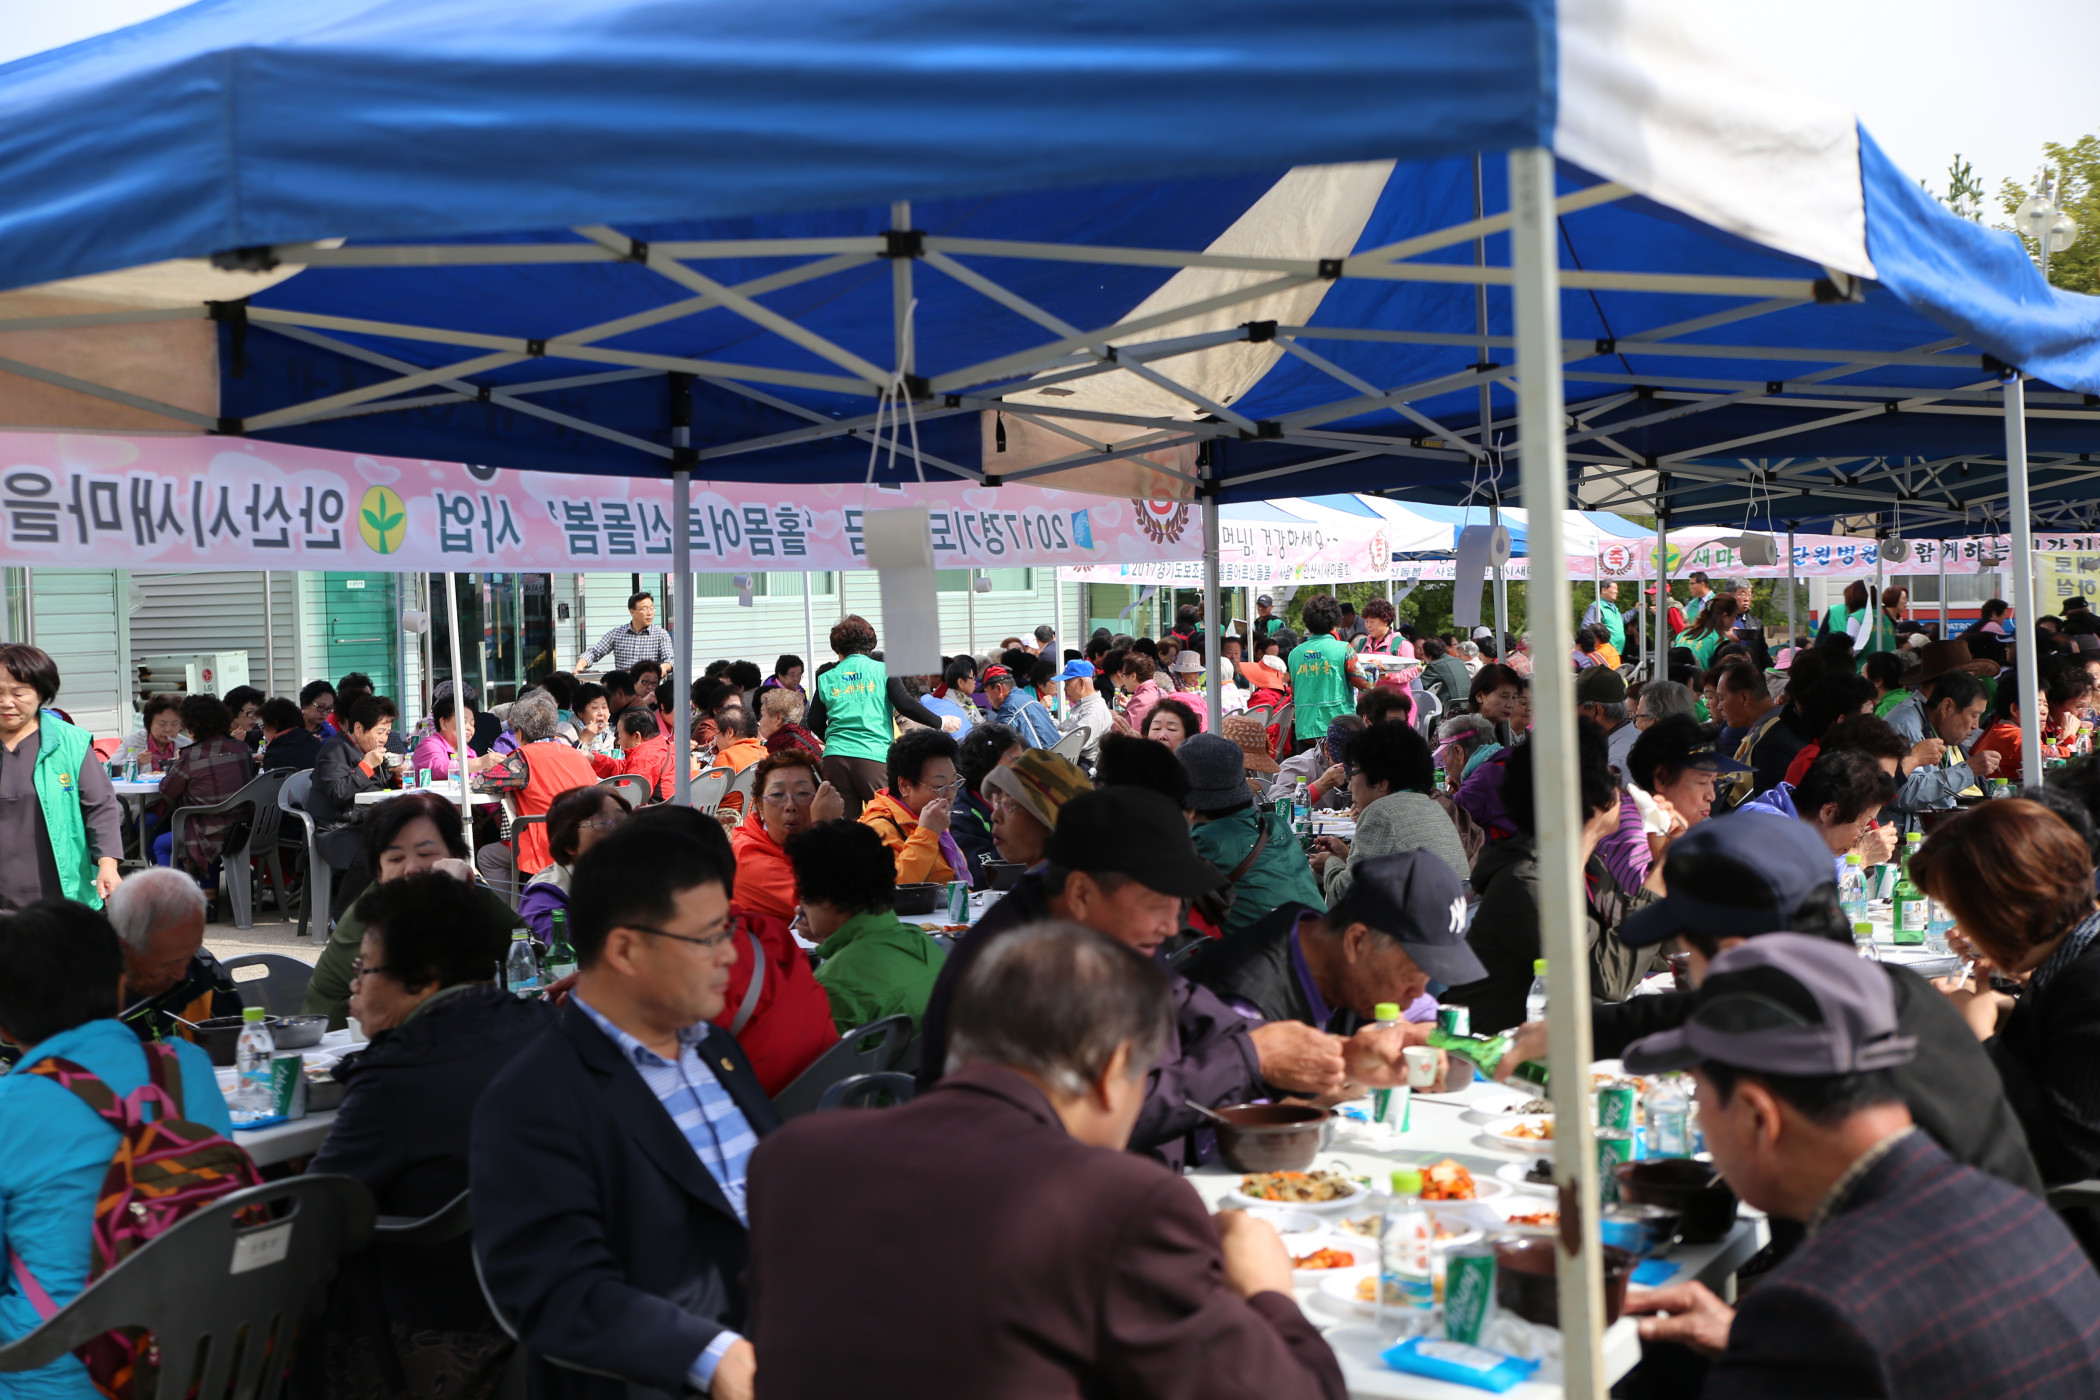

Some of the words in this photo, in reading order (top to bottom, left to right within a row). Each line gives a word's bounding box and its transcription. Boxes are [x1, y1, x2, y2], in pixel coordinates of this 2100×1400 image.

[1608, 547, 1624, 567] 축
[1303, 651, 1322, 660] SMU
[1296, 660, 1332, 677] 새마을
[841, 672, 863, 683] SMU
